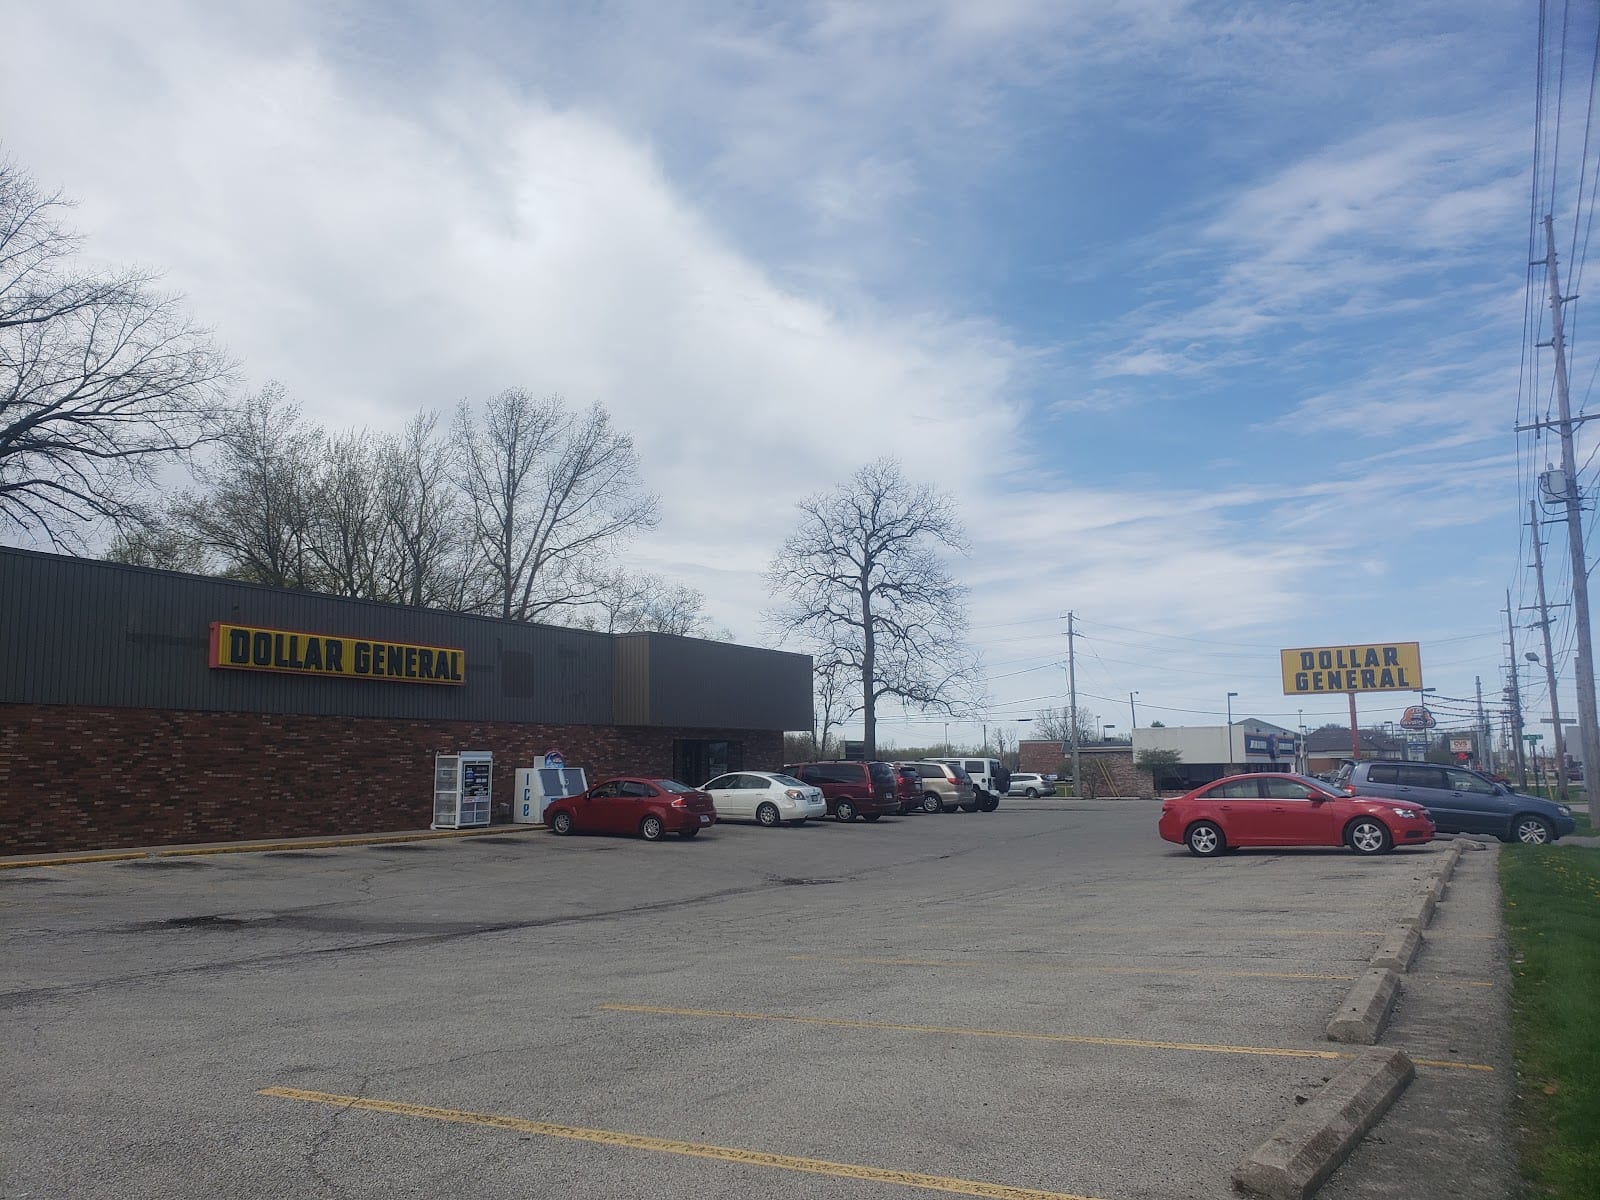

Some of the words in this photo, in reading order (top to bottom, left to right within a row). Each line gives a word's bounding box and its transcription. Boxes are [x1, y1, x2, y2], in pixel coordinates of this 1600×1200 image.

[230, 628, 344, 672] DOLLAR
[354, 641, 462, 681] GENERAL
[1300, 647, 1399, 670] DOLLAR
[1296, 668, 1409, 690] GENERAL
